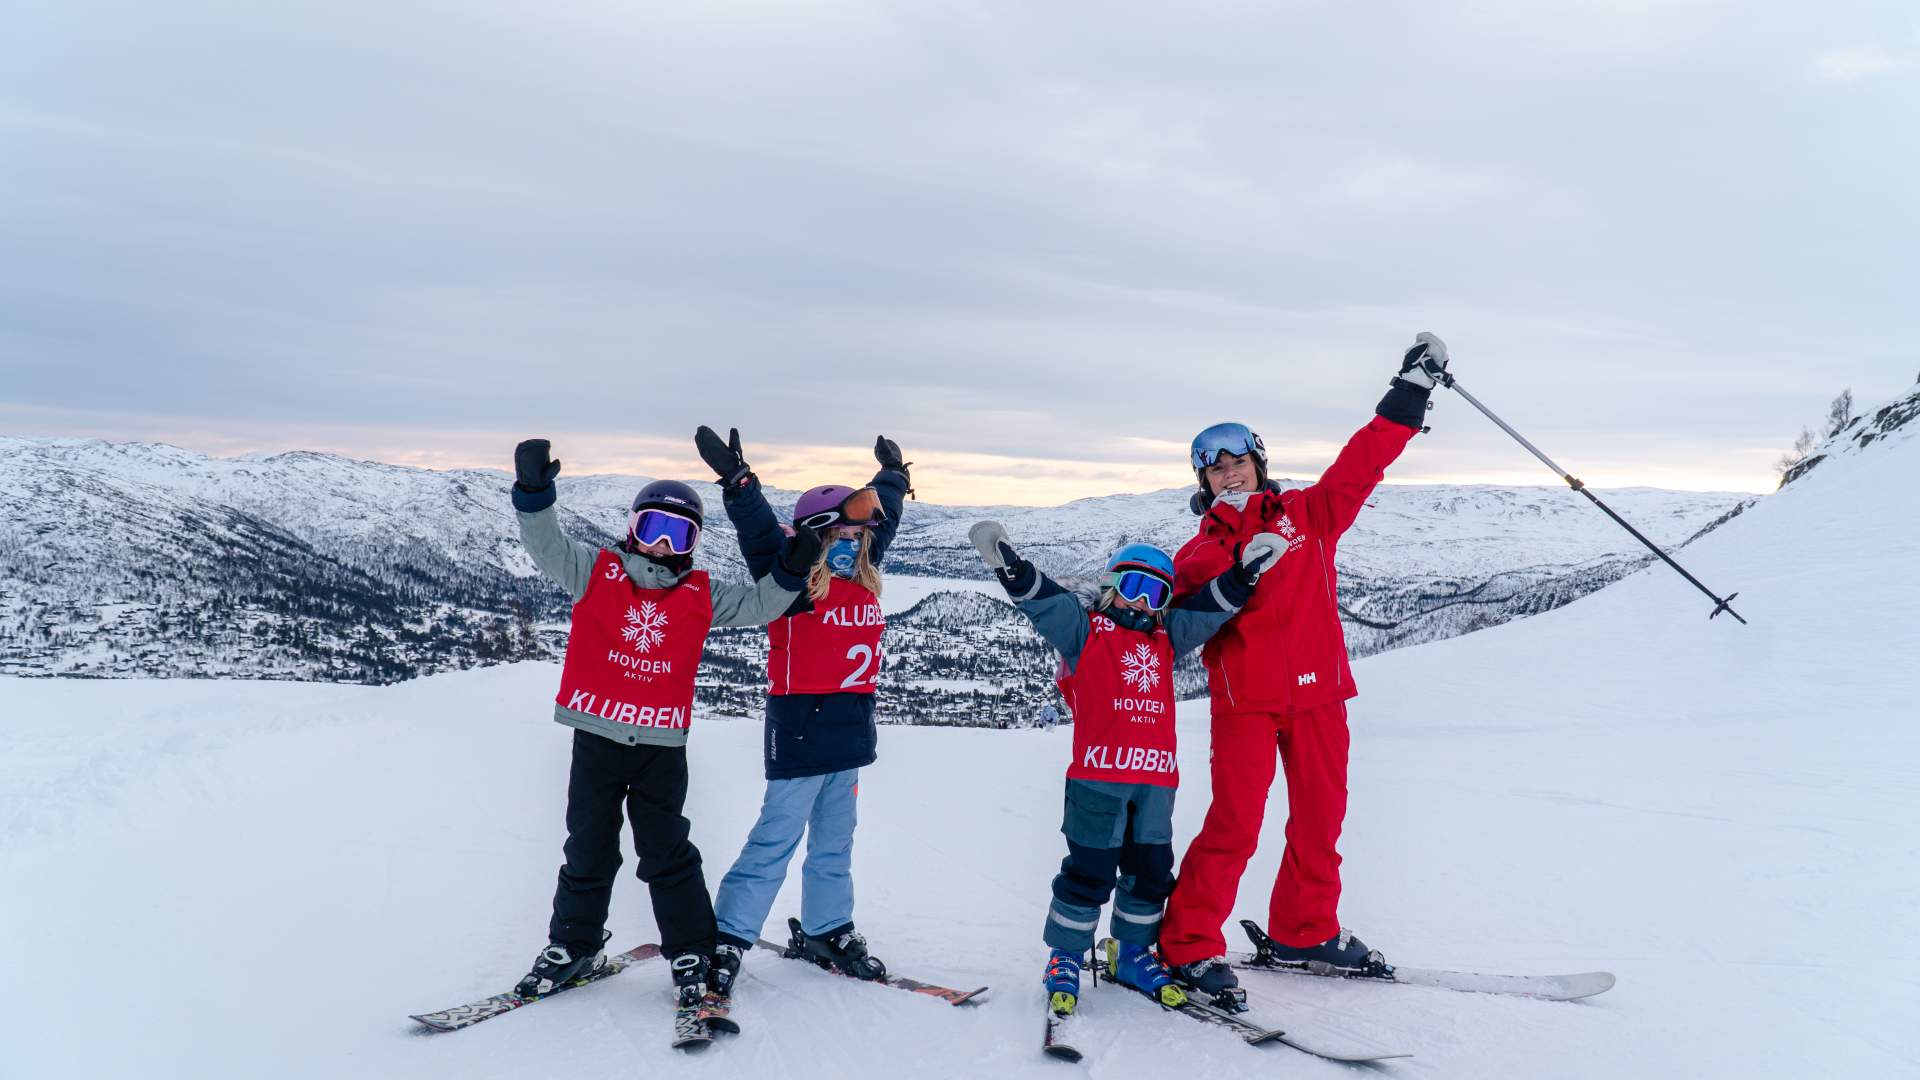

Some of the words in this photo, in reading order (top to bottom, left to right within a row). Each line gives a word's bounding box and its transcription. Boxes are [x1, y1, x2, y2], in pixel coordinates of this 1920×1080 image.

[1092, 615, 1116, 634] 29
[608, 650, 671, 673] HOVDEN
[624, 671, 653, 683] AKTIV
[1298, 671, 1317, 686] HH
[567, 689, 686, 729] KLUBBEN
[1113, 698, 1166, 714] HOVDEN
[1130, 715, 1156, 724] AKTIV
[1083, 745, 1177, 774] KLUBBEN
